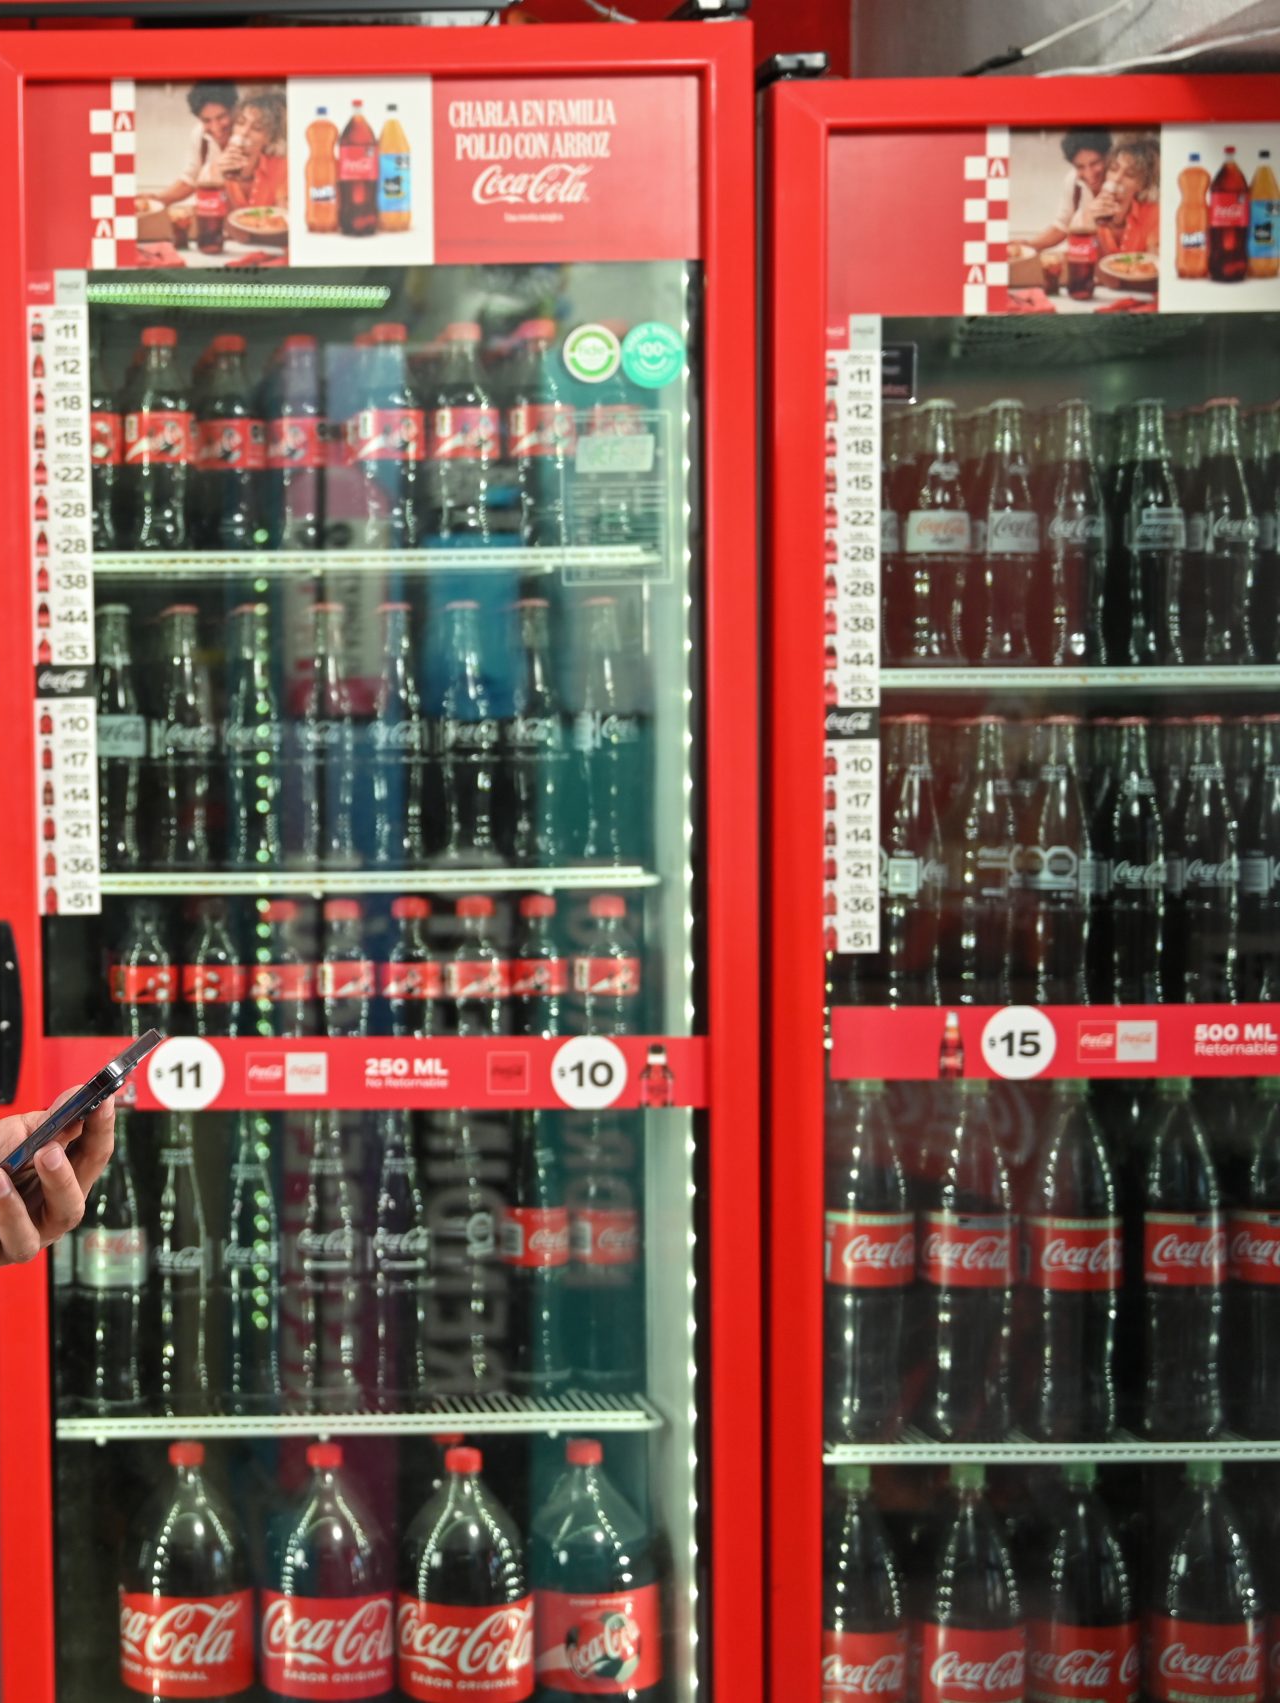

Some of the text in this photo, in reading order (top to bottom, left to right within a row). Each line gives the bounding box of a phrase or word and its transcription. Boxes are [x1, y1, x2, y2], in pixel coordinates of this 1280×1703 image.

[449, 98, 617, 128] CHARLA EN FAMILIA
[455, 131, 611, 160] POLLO CON ARROZ
[472, 163, 593, 204] Coca-Cola
[1195, 1022, 1278, 1041] 500 ML
[1195, 1041, 1278, 1056] Retornable
[155, 1062, 203, 1089] $11
[365, 1059, 448, 1076] 250 ML
[558, 1060, 614, 1088] $10
[365, 1076, 448, 1088] No Retornable
[120, 1599, 242, 1667] ca-Cola
[261, 1598, 393, 1667] Coca-Col
[1030, 1648, 1115, 1687] ca-Cola
[1159, 1642, 1260, 1685] Coca-Cola
[411, 1671, 519, 1692] SABOR ORIGINAL
